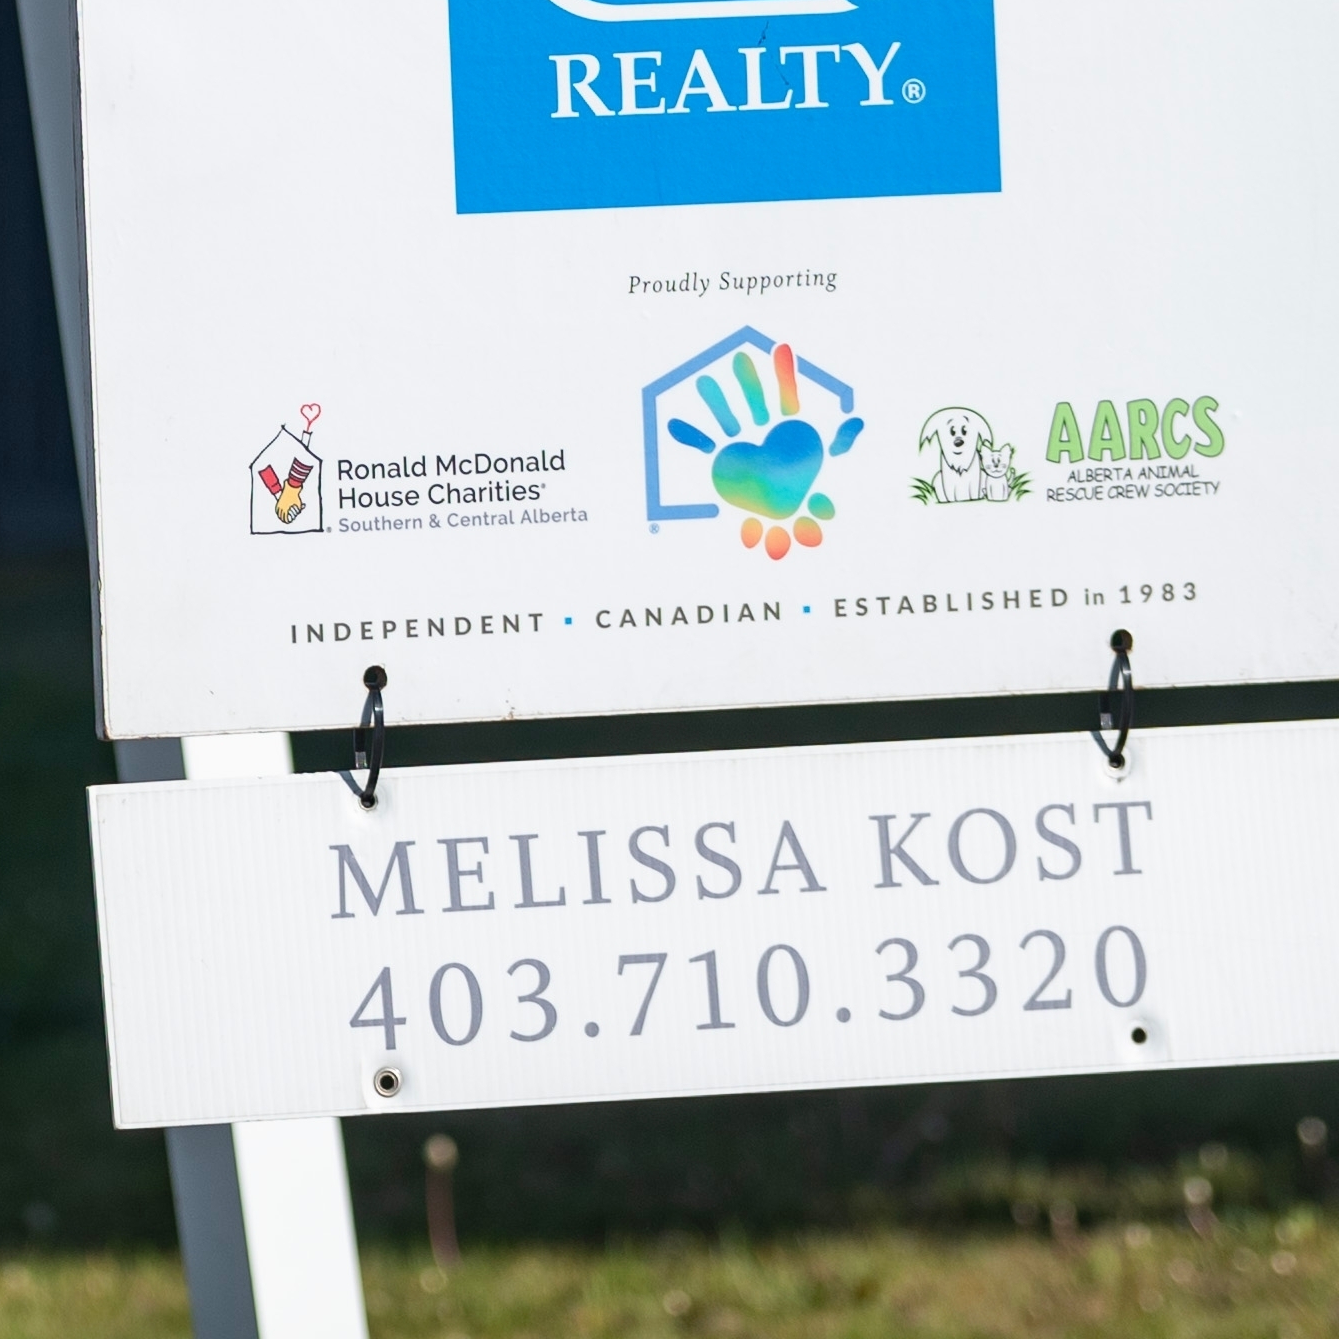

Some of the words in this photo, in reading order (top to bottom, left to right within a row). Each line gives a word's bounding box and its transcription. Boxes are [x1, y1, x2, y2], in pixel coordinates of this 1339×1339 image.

[629, 272, 709, 297] Proudly
[720, 269, 837, 295] Supporting
[1046, 395, 1225, 464] AARCS
[338, 455, 427, 481] Ronald
[436, 449, 565, 476] McDonald
[1067, 468, 1133, 483] ALBERTA
[1138, 465, 1199, 479] ANIMAL
[339, 487, 419, 509] House
[1047, 485, 1103, 502] RESCUE
[1108, 484, 1150, 499] CREW
[1155, 481, 1219, 497] SOCIETY
[339, 516, 422, 532] Southern
[429, 514, 441, 528] &
[447, 510, 514, 527] Central
[521, 508, 587, 524] Alberta
[291, 613, 543, 643] INDEPENDENT
[596, 602, 780, 628] CANADIAN
[835, 588, 1068, 617] ESTABLISHED
[1085, 588, 1104, 605] in
[1120, 582, 1196, 604] 1983
[329, 820, 827, 919] MELISSA
[869, 801, 1152, 888] KOST
[350, 926, 1147, 1050] 403.710.3320
